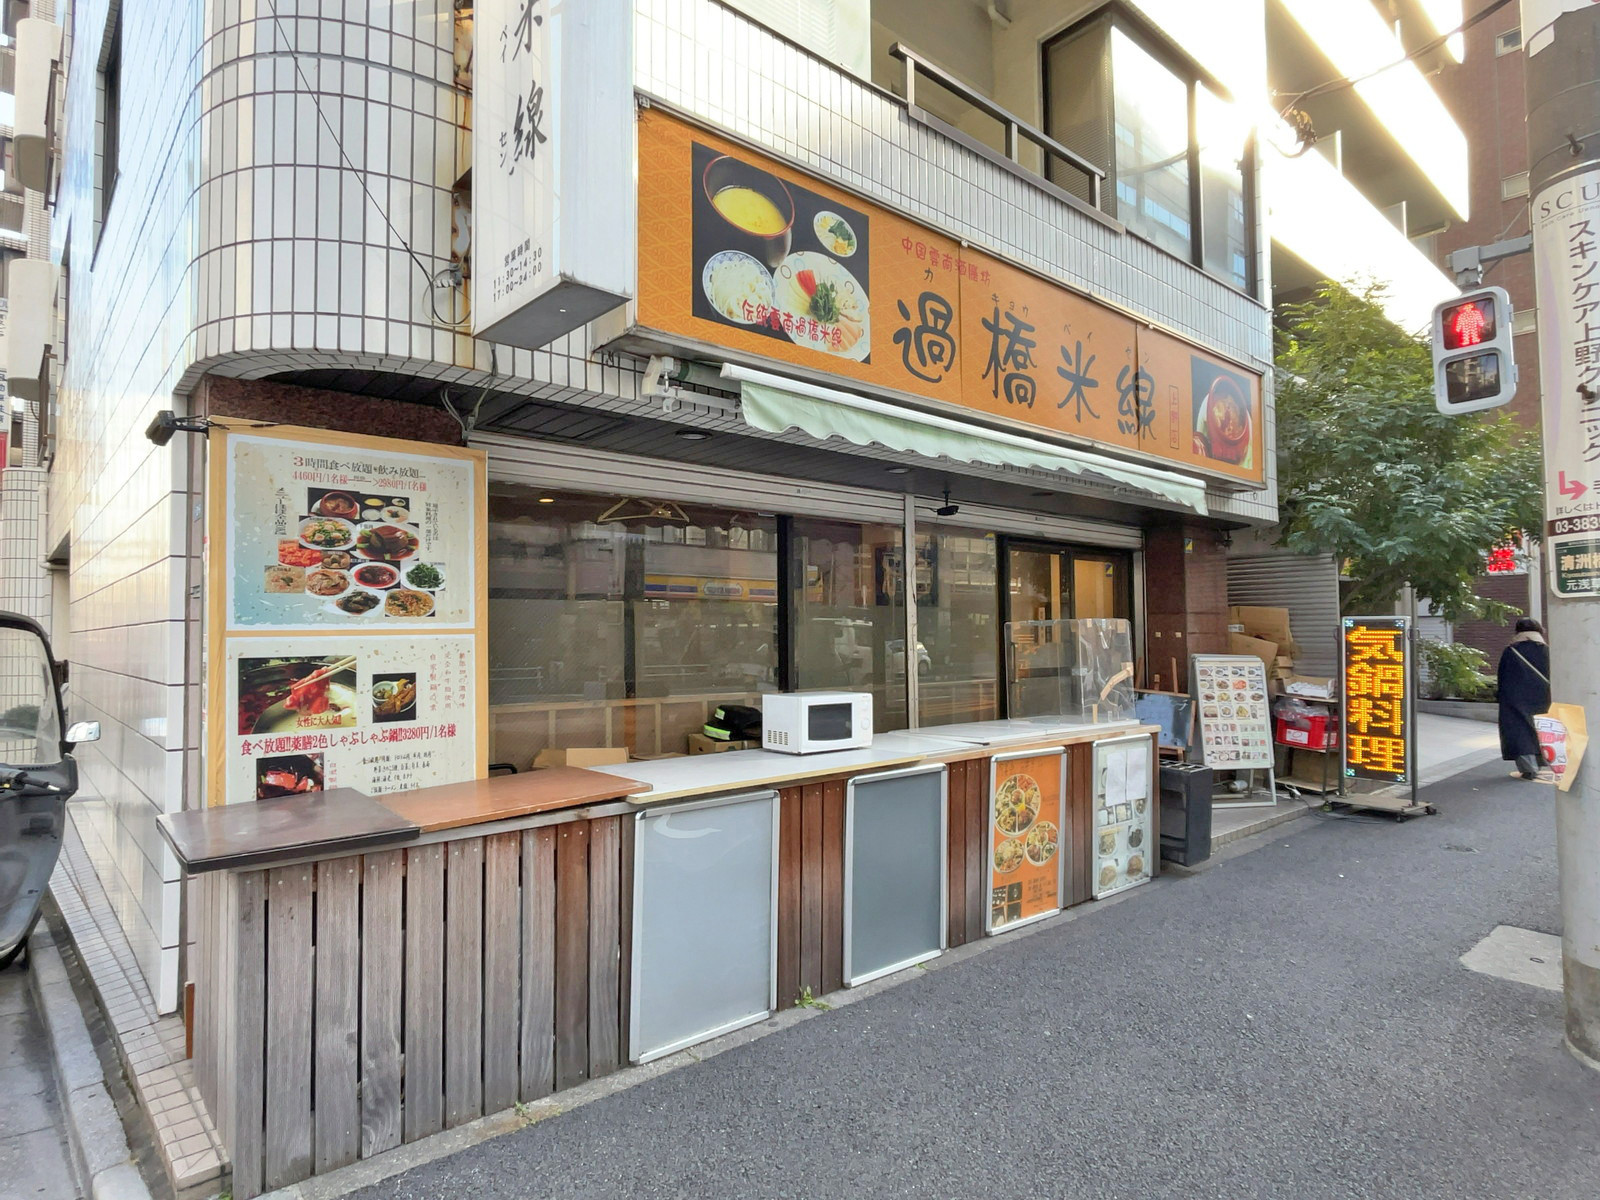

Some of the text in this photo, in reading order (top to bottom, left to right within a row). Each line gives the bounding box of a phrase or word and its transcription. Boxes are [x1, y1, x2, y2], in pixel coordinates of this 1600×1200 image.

[893, 290, 1157, 441] 過橋米線
[1555, 516, 1600, 533] 03-383
